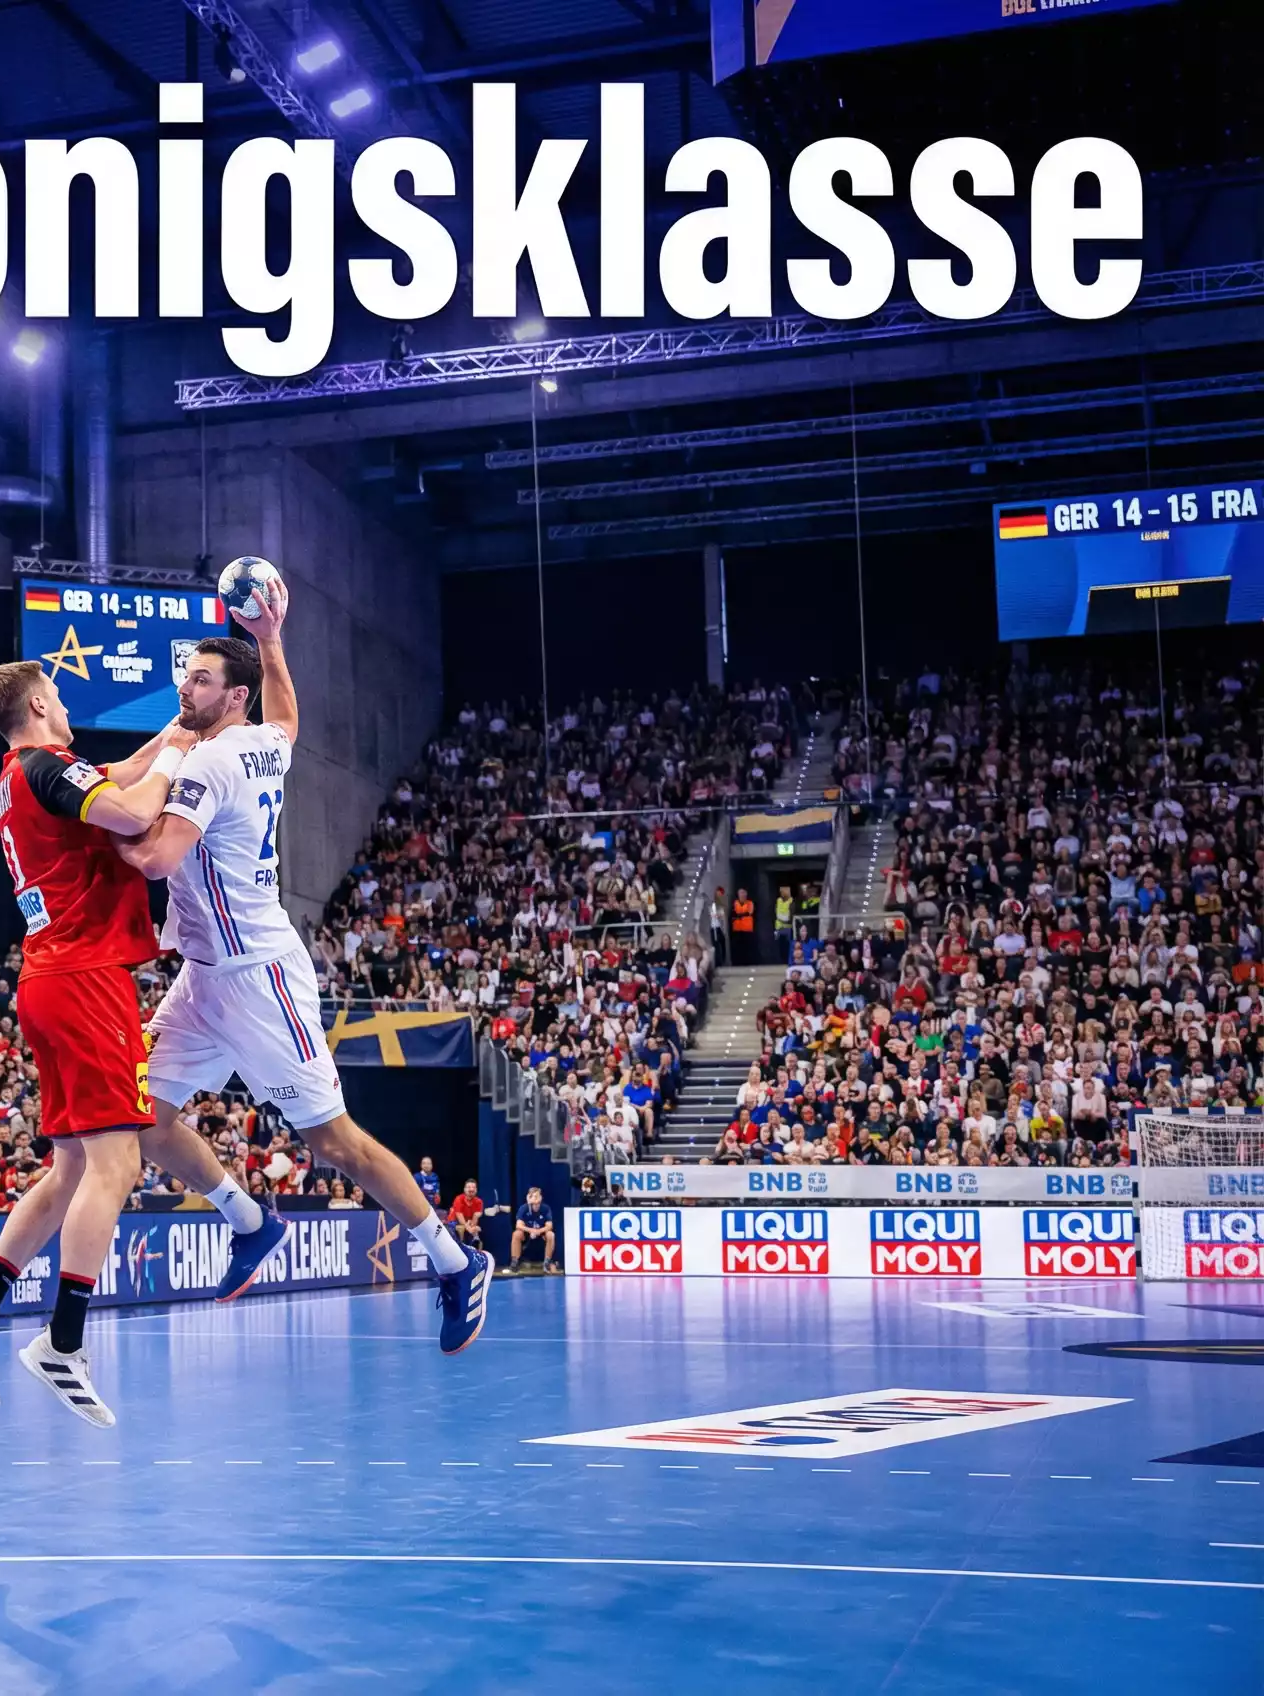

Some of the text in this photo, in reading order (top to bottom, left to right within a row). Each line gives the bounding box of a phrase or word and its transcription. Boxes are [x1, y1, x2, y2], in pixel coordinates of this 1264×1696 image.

[1054, 502, 1099, 532] GER
[1112, 497, 1143, 527] 14
[1167, 492, 1198, 523] 15
[1211, 488, 1258, 519] FRA
[63, 589, 93, 613] GER
[100, 592, 120, 615] 14
[134, 595, 154, 618] 15
[159, 597, 190, 620] FRA
[609, 1171, 662, 1192] BNB
[748, 1171, 803, 1193] BNB
[895, 1172, 953, 1193] BNB
[1046, 1173, 1106, 1195] BNB
[584, 1211, 677, 1240] LIQUI
[726, 1211, 824, 1241] LIQUI
[875, 1211, 975, 1242] LIQUI
[1029, 1211, 1133, 1242] LIQUI
[168, 1222, 287, 1290] CHAMNS
[289, 1220, 351, 1281] LEAGUE
[585, 1243, 681, 1272] MOLY
[727, 1244, 827, 1272] MOLY
[876, 1245, 979, 1273] MOLY
[1031, 1245, 1135, 1274] MOLY
